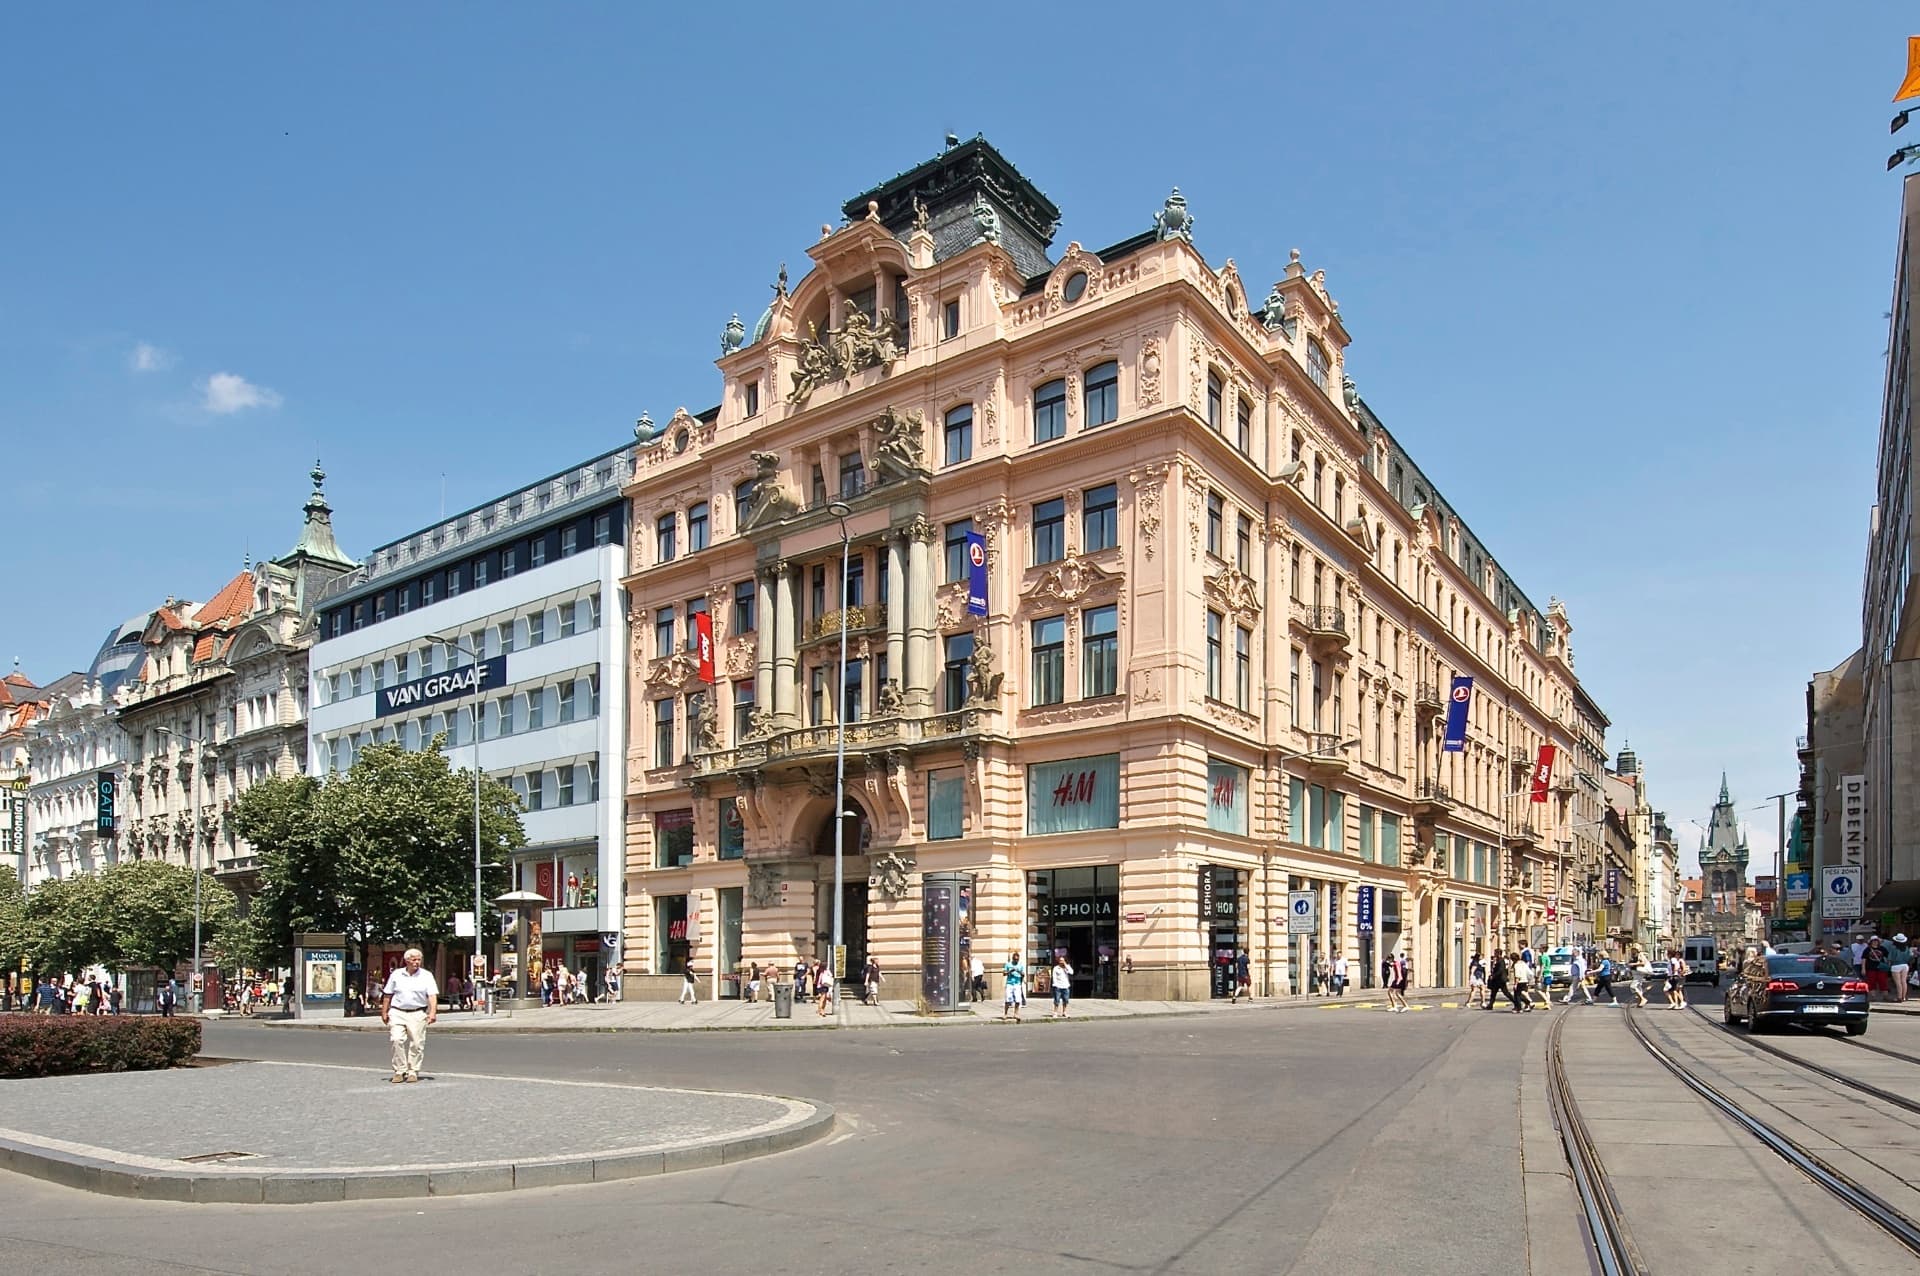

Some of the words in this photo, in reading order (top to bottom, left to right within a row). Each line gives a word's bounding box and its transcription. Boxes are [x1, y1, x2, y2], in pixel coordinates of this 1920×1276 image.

[387, 683, 420, 707] VAN
[424, 665, 488, 698] GRAAF
[101, 781, 113, 827] GATE
[1053, 770, 1096, 807] H&M
[1042, 902, 1112, 917] SEPHORA
[1204, 871, 1212, 916] SEPHORA
[1362, 887, 1370, 920] CHANGE
[1360, 922, 1373, 930] 0%
[311, 952, 338, 960] MUCHA
[544, 958, 563, 969] ALE
